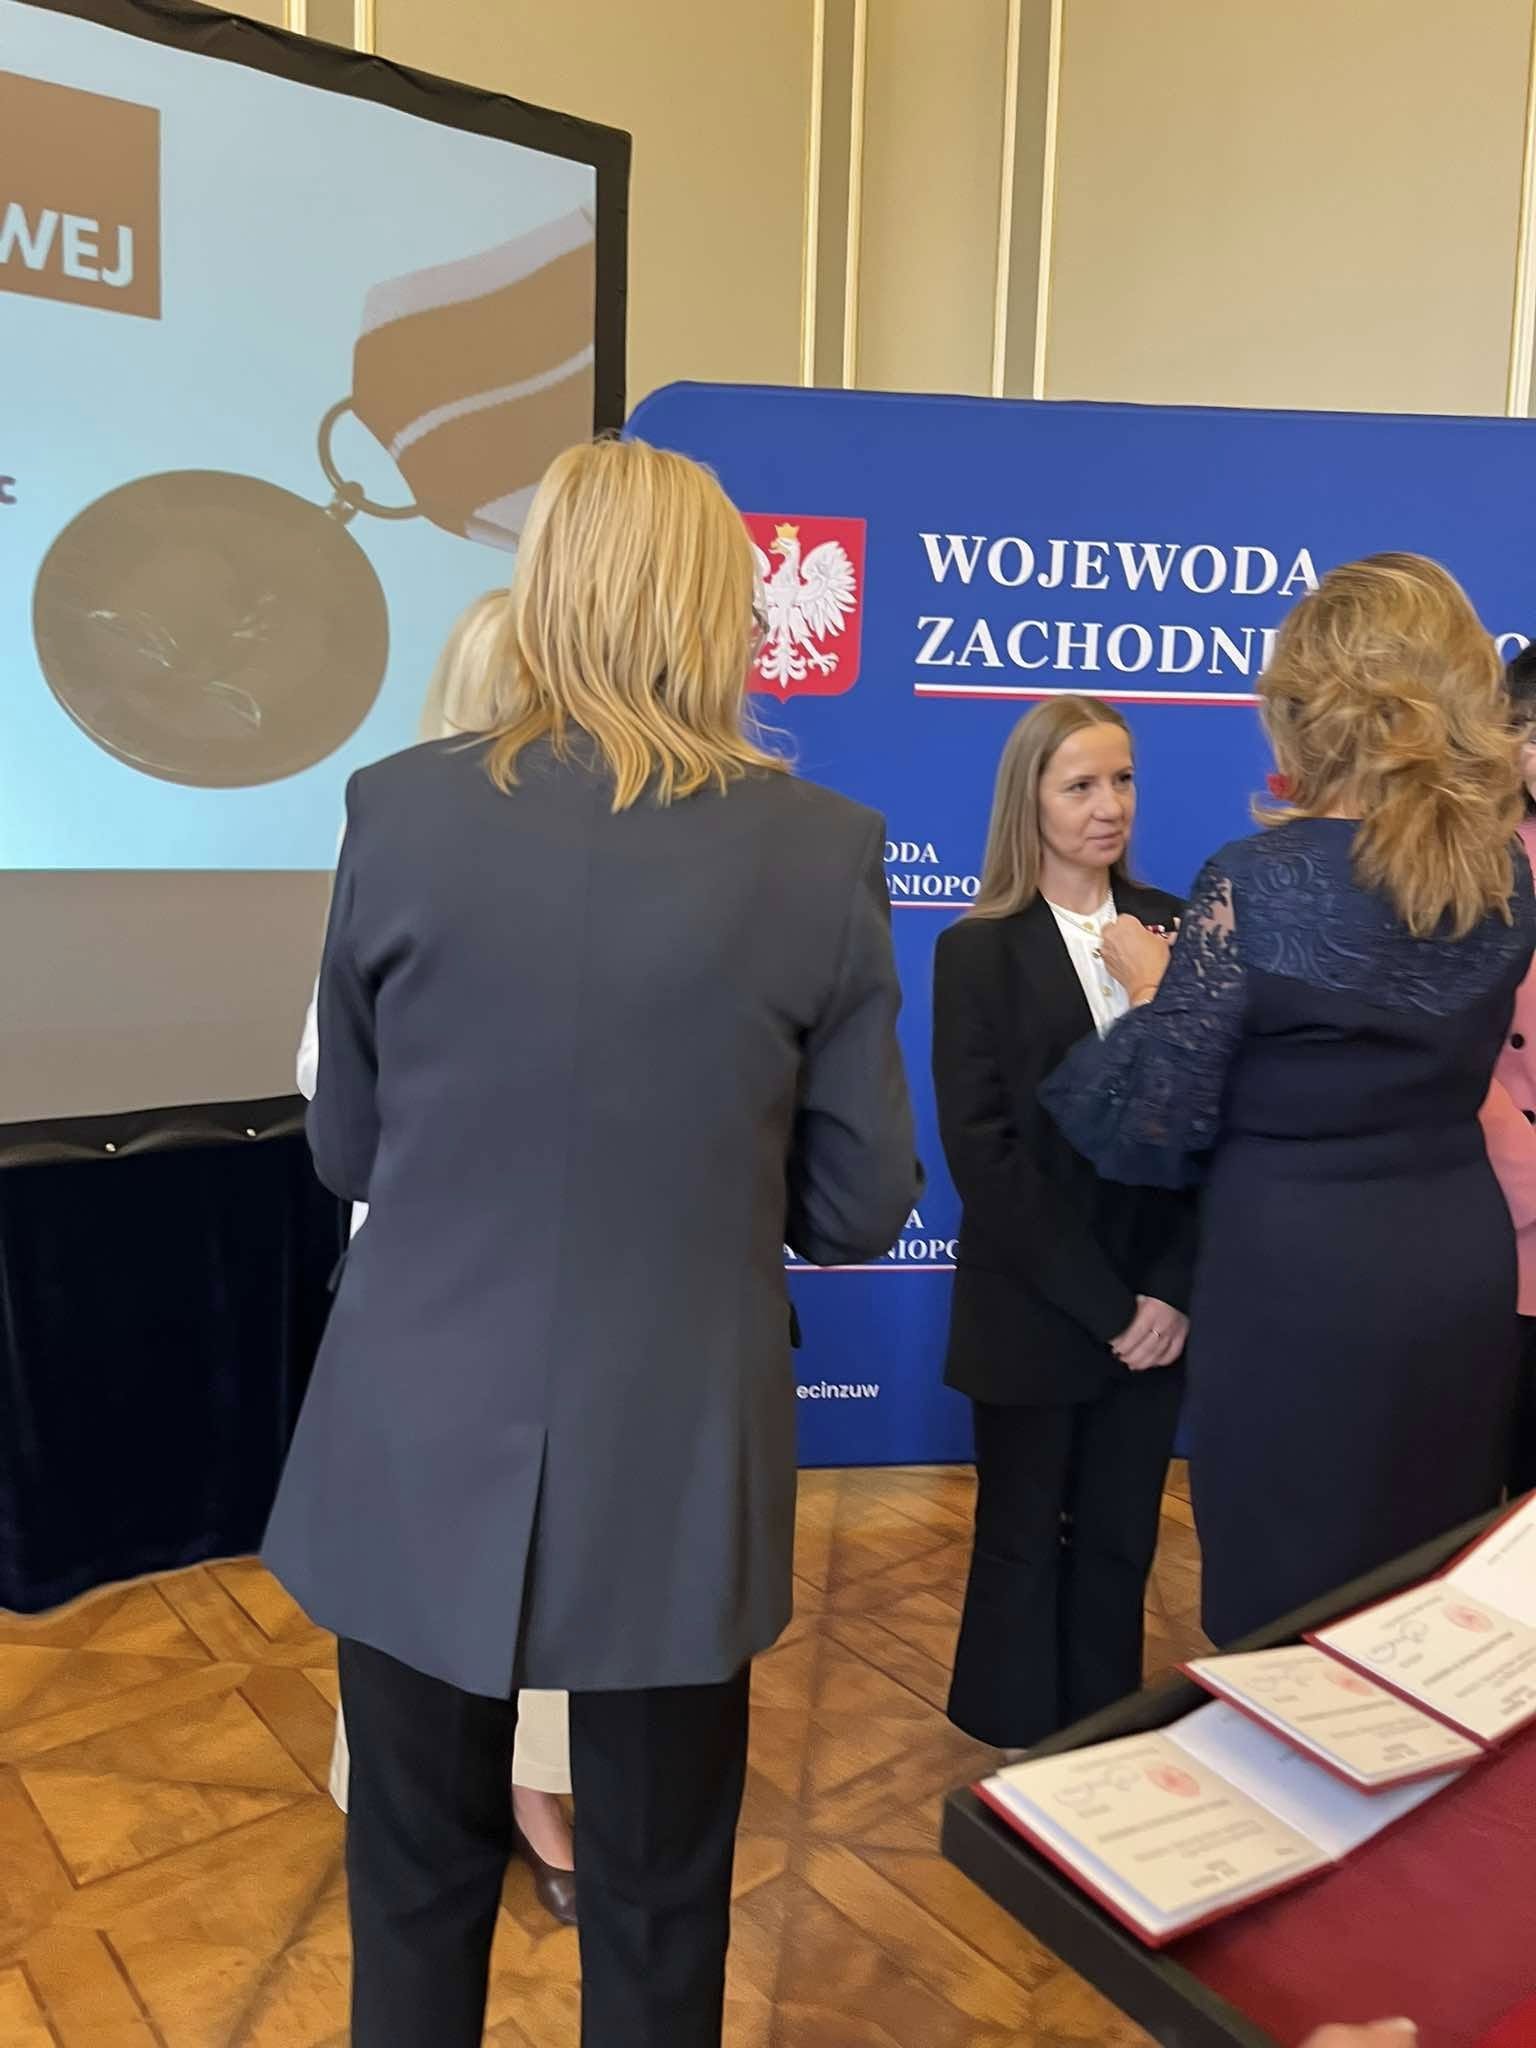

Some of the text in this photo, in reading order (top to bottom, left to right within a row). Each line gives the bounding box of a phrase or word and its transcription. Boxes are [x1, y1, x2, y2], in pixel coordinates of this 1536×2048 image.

[918, 532, 1320, 596] WOJEWODA
[886, 873, 981, 897] NIOPO
[796, 1380, 880, 1399] ecinzuw
